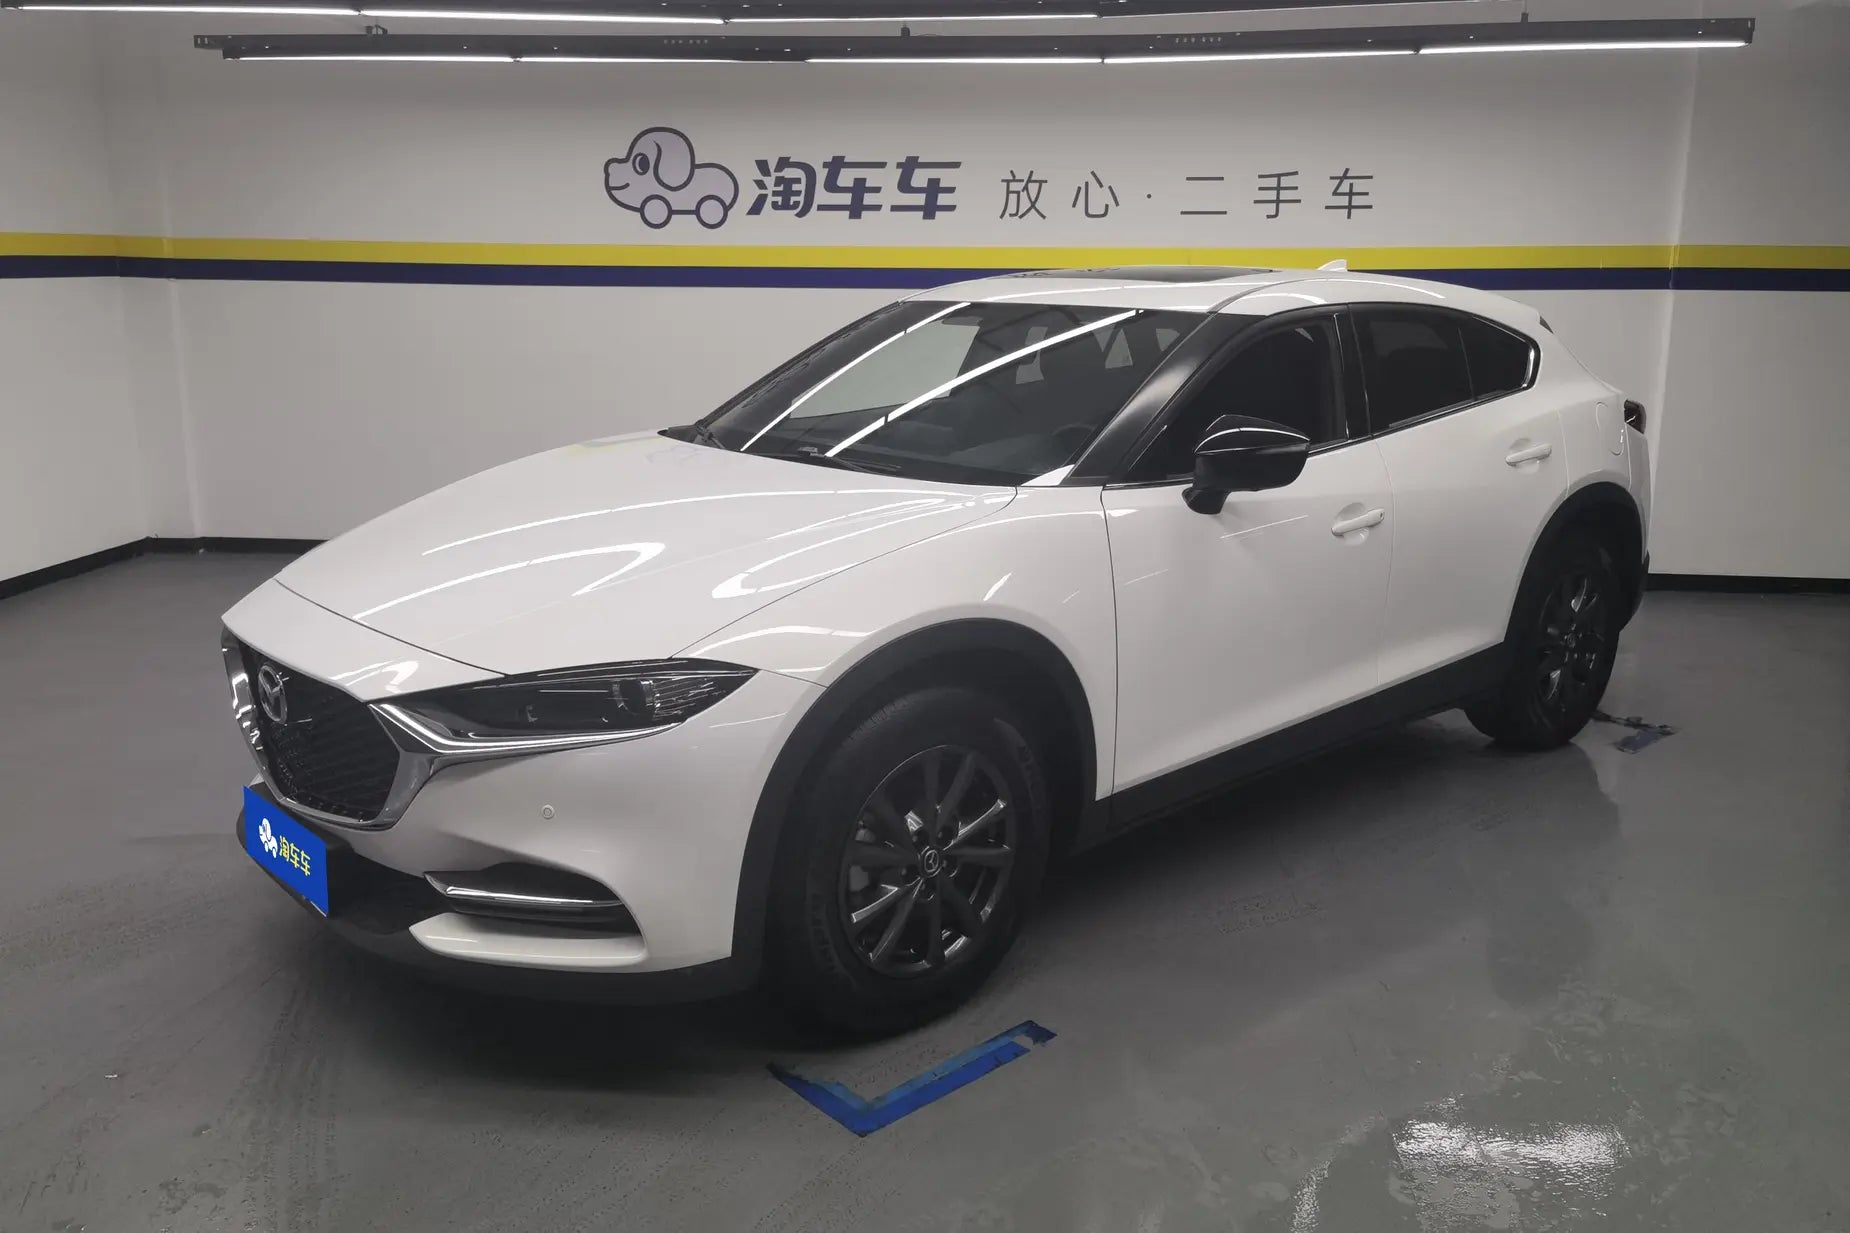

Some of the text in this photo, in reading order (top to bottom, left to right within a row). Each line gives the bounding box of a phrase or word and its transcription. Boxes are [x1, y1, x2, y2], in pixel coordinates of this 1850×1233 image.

[746, 156, 962, 220] 淘车车
[279, 835, 311, 877] 淘车车
